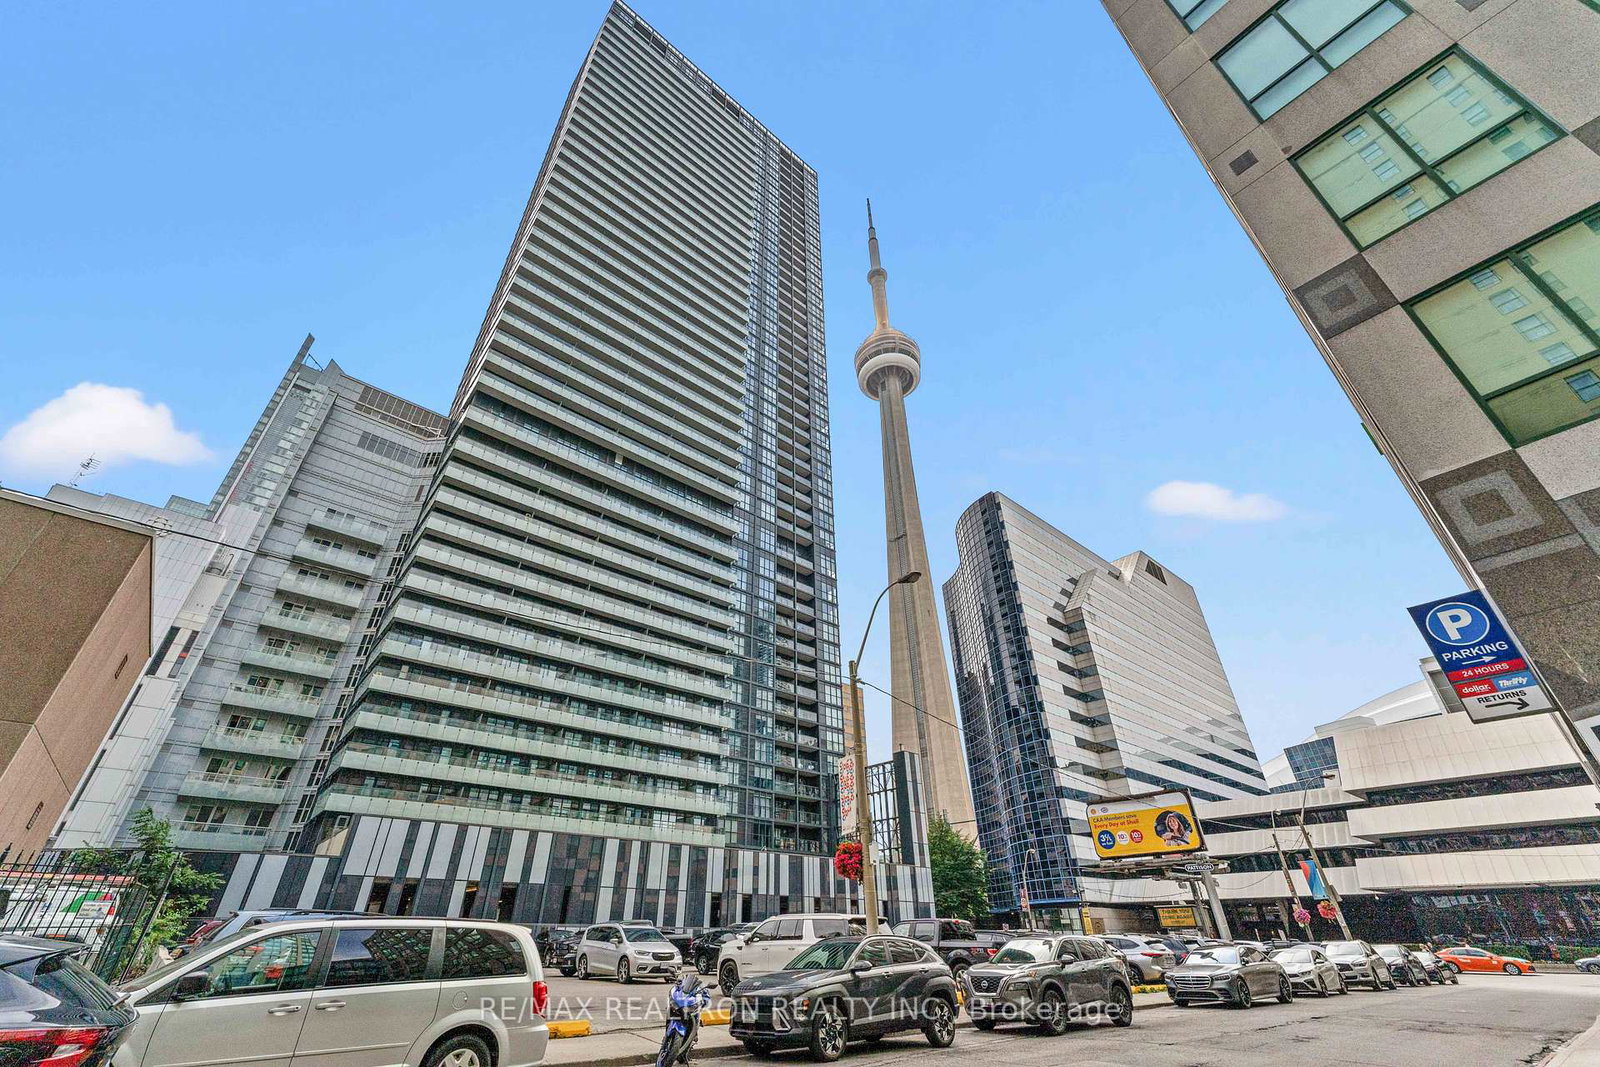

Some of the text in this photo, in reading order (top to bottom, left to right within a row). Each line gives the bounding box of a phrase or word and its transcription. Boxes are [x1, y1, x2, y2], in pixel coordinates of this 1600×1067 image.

[1437, 608, 1472, 641] P
[1442, 641, 1509, 662] PARKING
[1461, 663, 1509, 678] 24 HOURS
[1498, 676, 1528, 688] Thrifty
[1476, 690, 1527, 704] RETURNS
